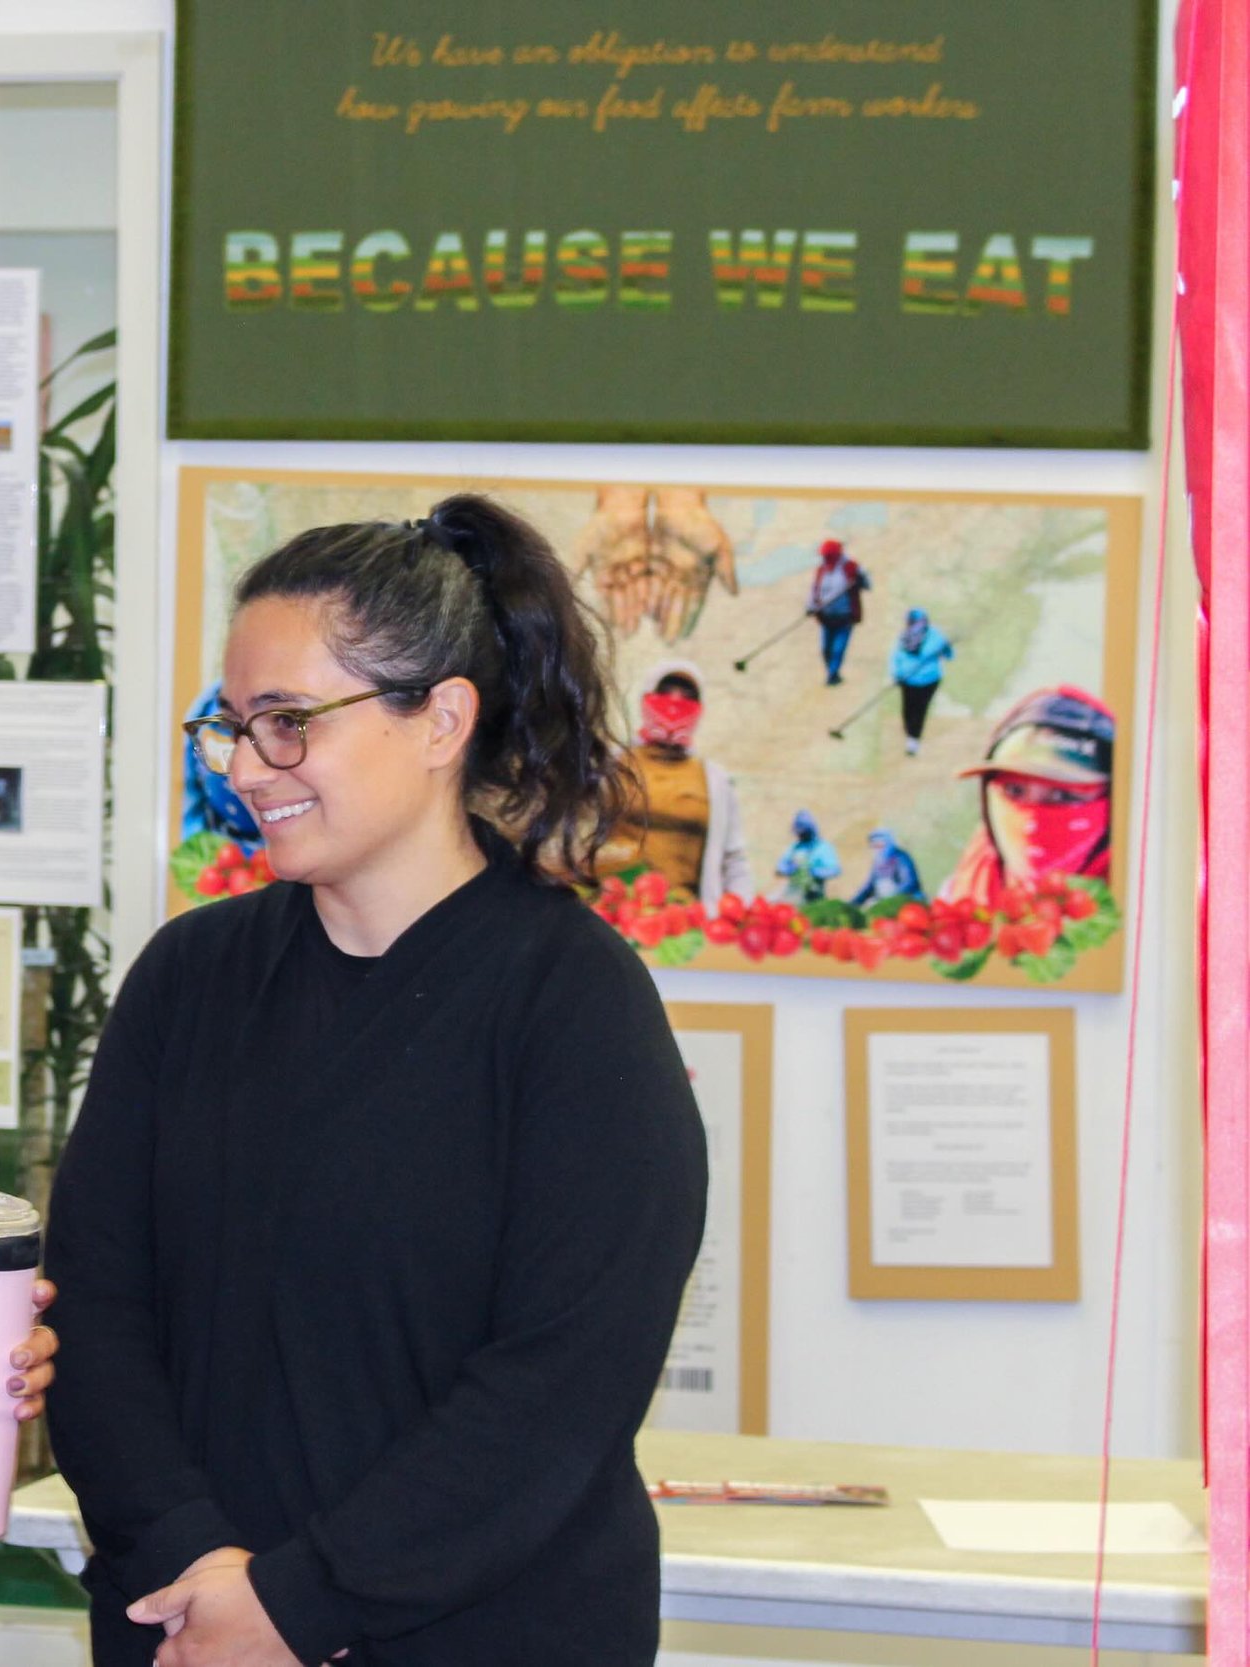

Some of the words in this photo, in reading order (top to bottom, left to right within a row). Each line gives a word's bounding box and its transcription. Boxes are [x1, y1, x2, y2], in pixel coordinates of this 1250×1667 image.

[371, 31, 422, 68] We
[431, 33, 503, 67] have
[512, 46, 559, 65] an
[567, 31, 717, 79] obligation
[725, 40, 758, 64] to
[767, 33, 946, 65] understand
[336, 85, 399, 120] how
[405, 99, 531, 135] growing
[536, 98, 588, 119] our
[593, 83, 665, 133] food
[671, 83, 763, 133] affects
[766, 80, 853, 133] farm
[862, 81, 981, 120] workers
[223, 229, 673, 313] BECAUSE
[708, 229, 859, 314] WE
[900, 230, 1094, 317] EAT
